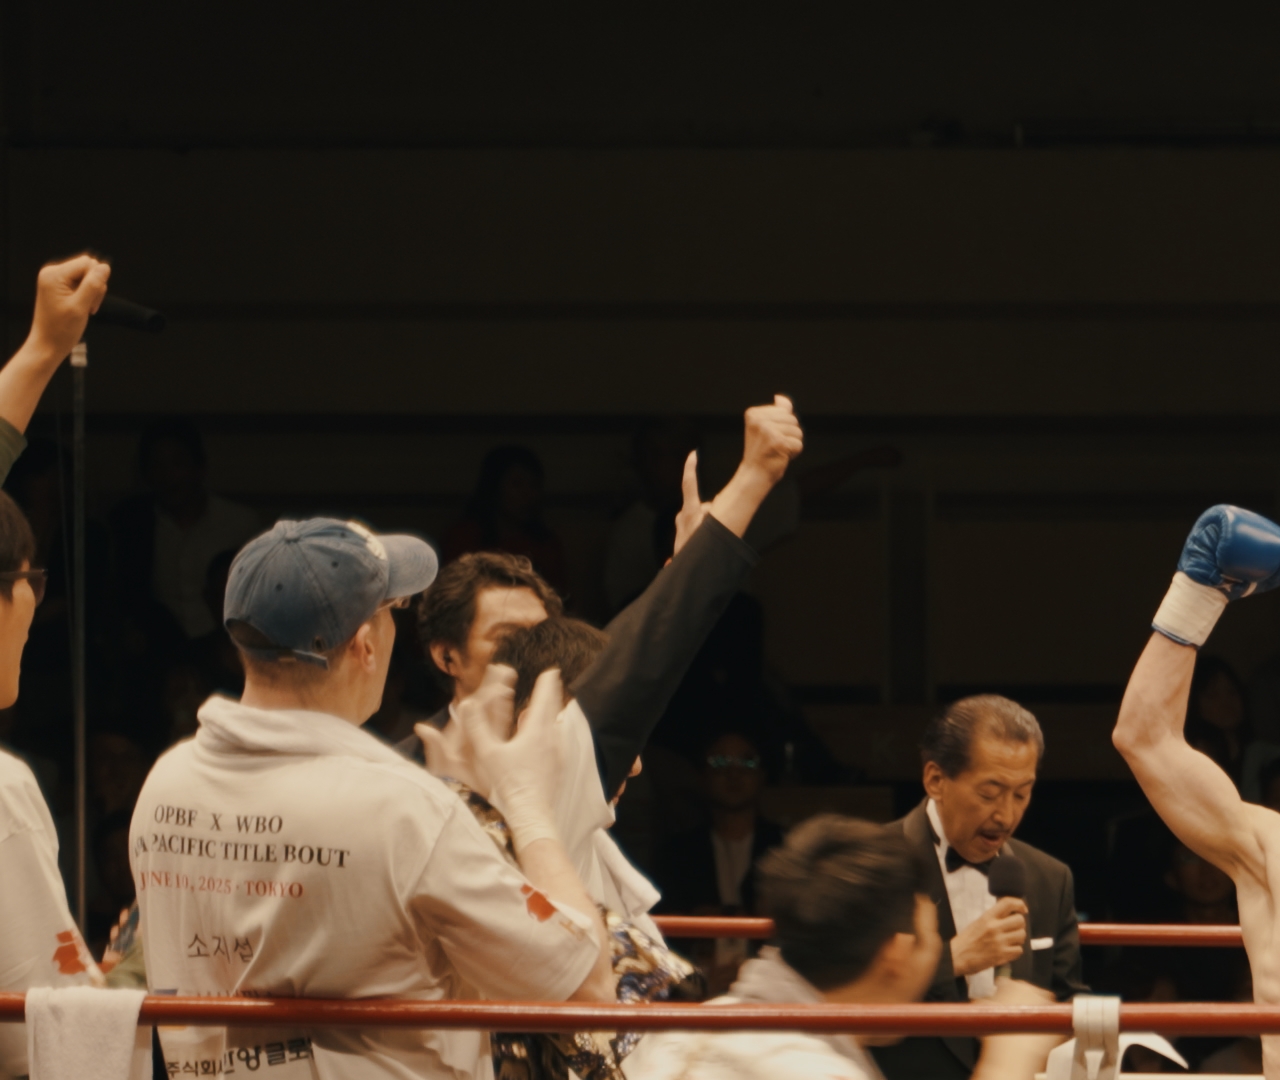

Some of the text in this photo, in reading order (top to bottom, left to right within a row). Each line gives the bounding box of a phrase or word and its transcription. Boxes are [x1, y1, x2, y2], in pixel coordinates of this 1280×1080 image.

[154, 804, 283, 834] OPBF X WBO
[220, 842, 277, 863] TITLE
[282, 844, 350, 868] BOUT
[140, 871, 173, 892] JNE
[199, 877, 232, 896] 2025
[244, 881, 304, 899] TOKYO
[188, 933, 254, 964] 소지섭
